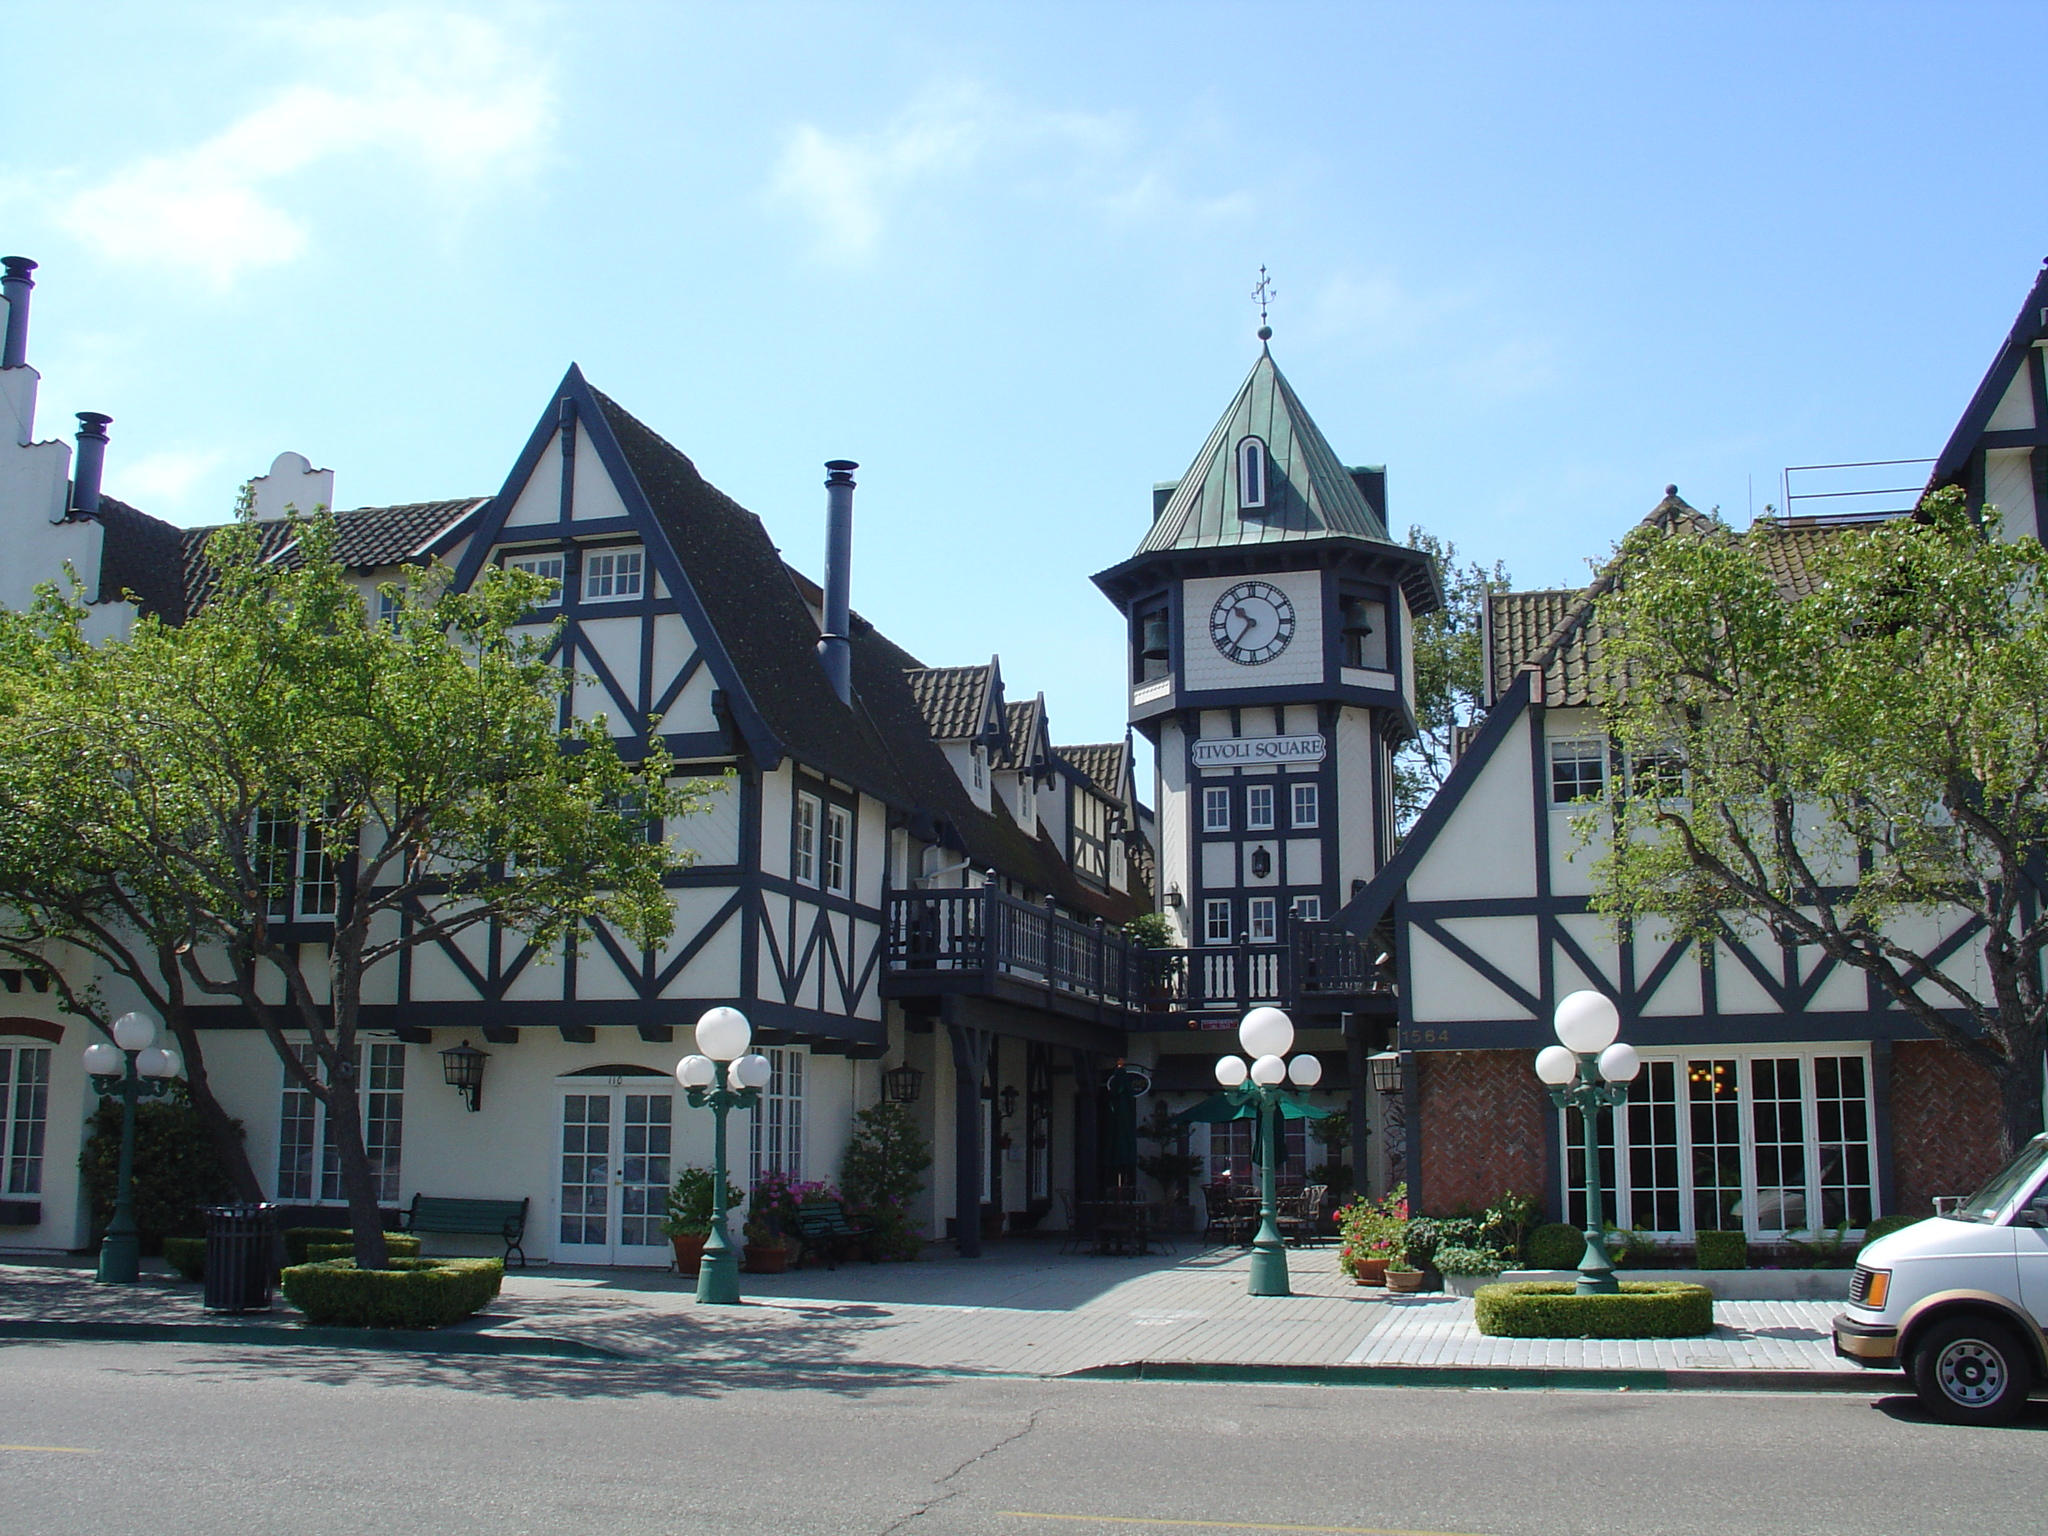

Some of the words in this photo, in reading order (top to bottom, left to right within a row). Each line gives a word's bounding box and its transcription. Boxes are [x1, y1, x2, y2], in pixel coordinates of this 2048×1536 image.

[1197, 743, 1251, 760] TIVOLI
[1256, 740, 1322, 758] SQUARE
[1401, 1030, 1449, 1043] 1564
